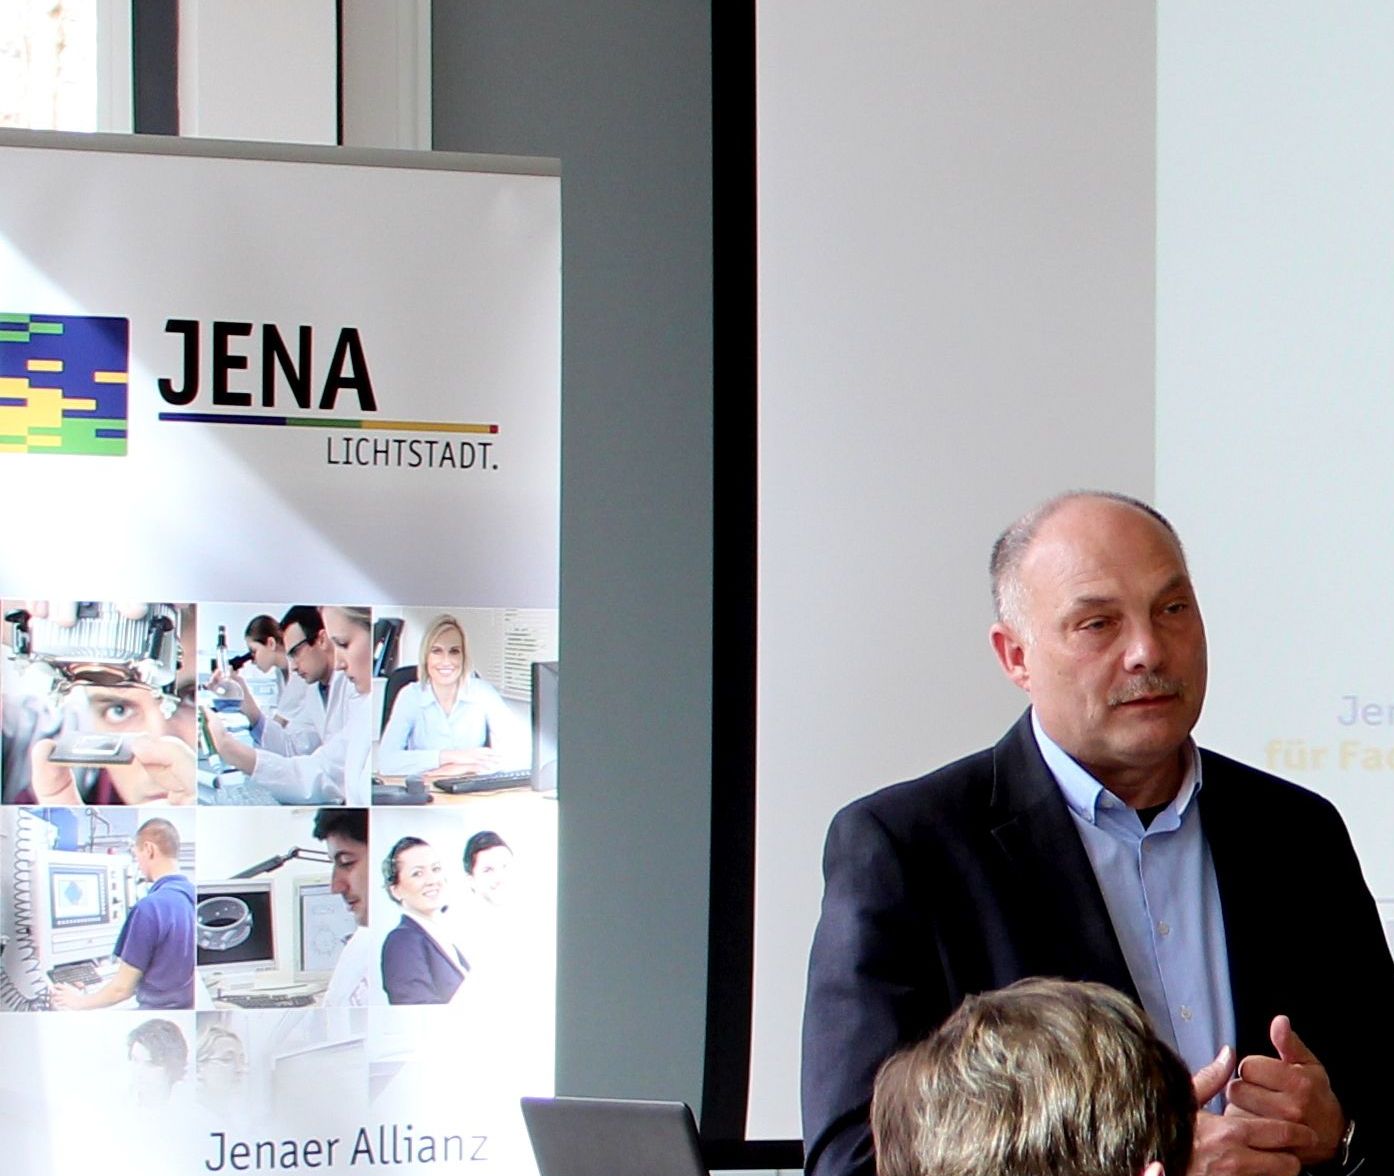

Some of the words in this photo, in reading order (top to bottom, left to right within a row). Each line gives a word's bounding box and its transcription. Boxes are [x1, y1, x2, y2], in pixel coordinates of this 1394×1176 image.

[158, 319, 378, 412] JENA
[327, 436, 499, 471] LICHTSTADT.
[1264, 739, 1327, 771] für
[205, 1131, 340, 1172] Jenaer
[351, 1125, 489, 1166] Allianz
